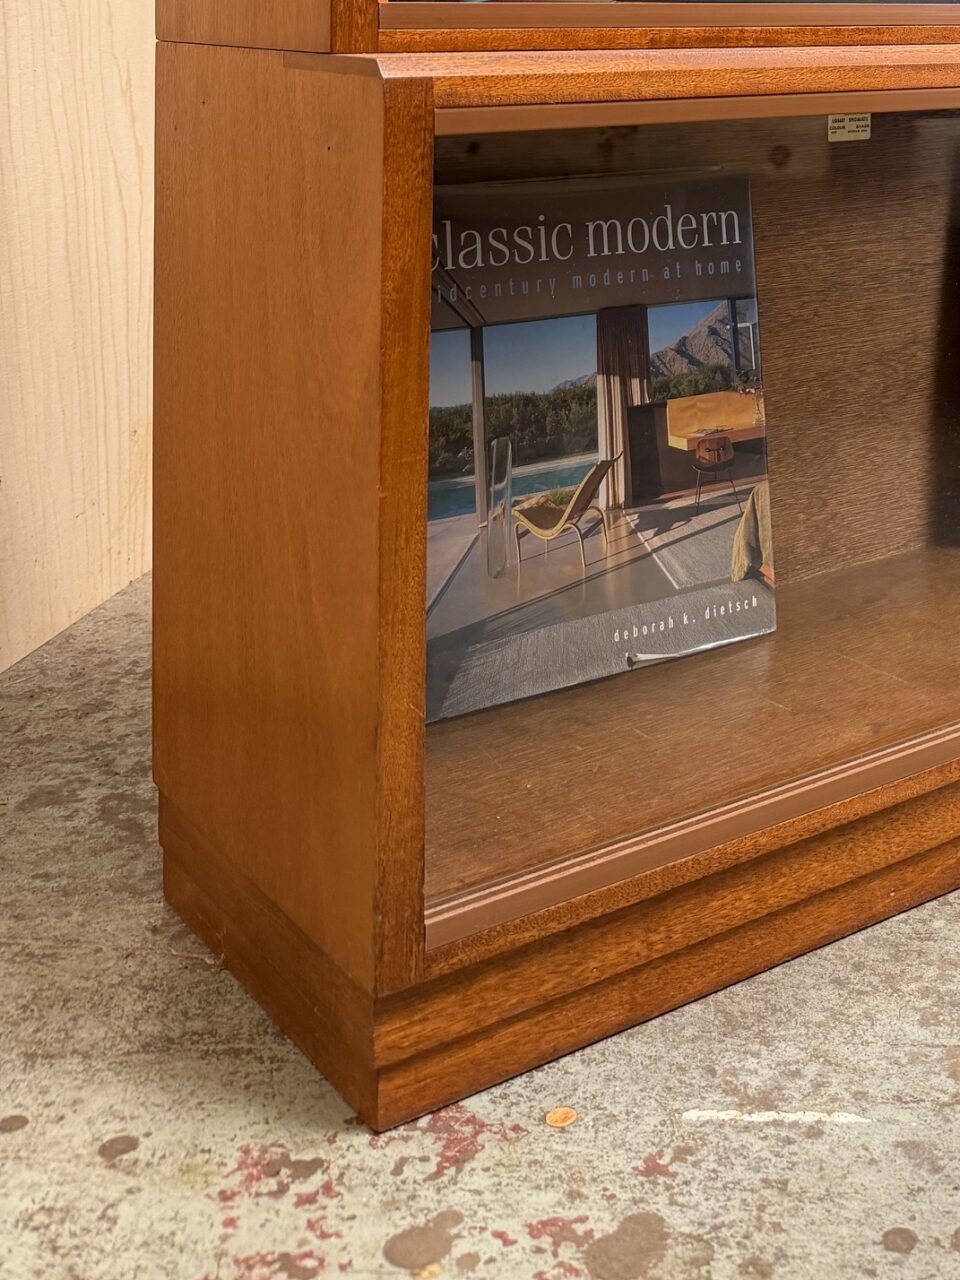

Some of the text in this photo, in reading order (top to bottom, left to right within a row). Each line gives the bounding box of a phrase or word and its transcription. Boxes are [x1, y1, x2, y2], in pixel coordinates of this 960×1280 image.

[585, 205, 742, 257] modern
[437, 257, 743, 304] idcentury modern at home
[614, 595, 758, 642] deborah k. dietsch
